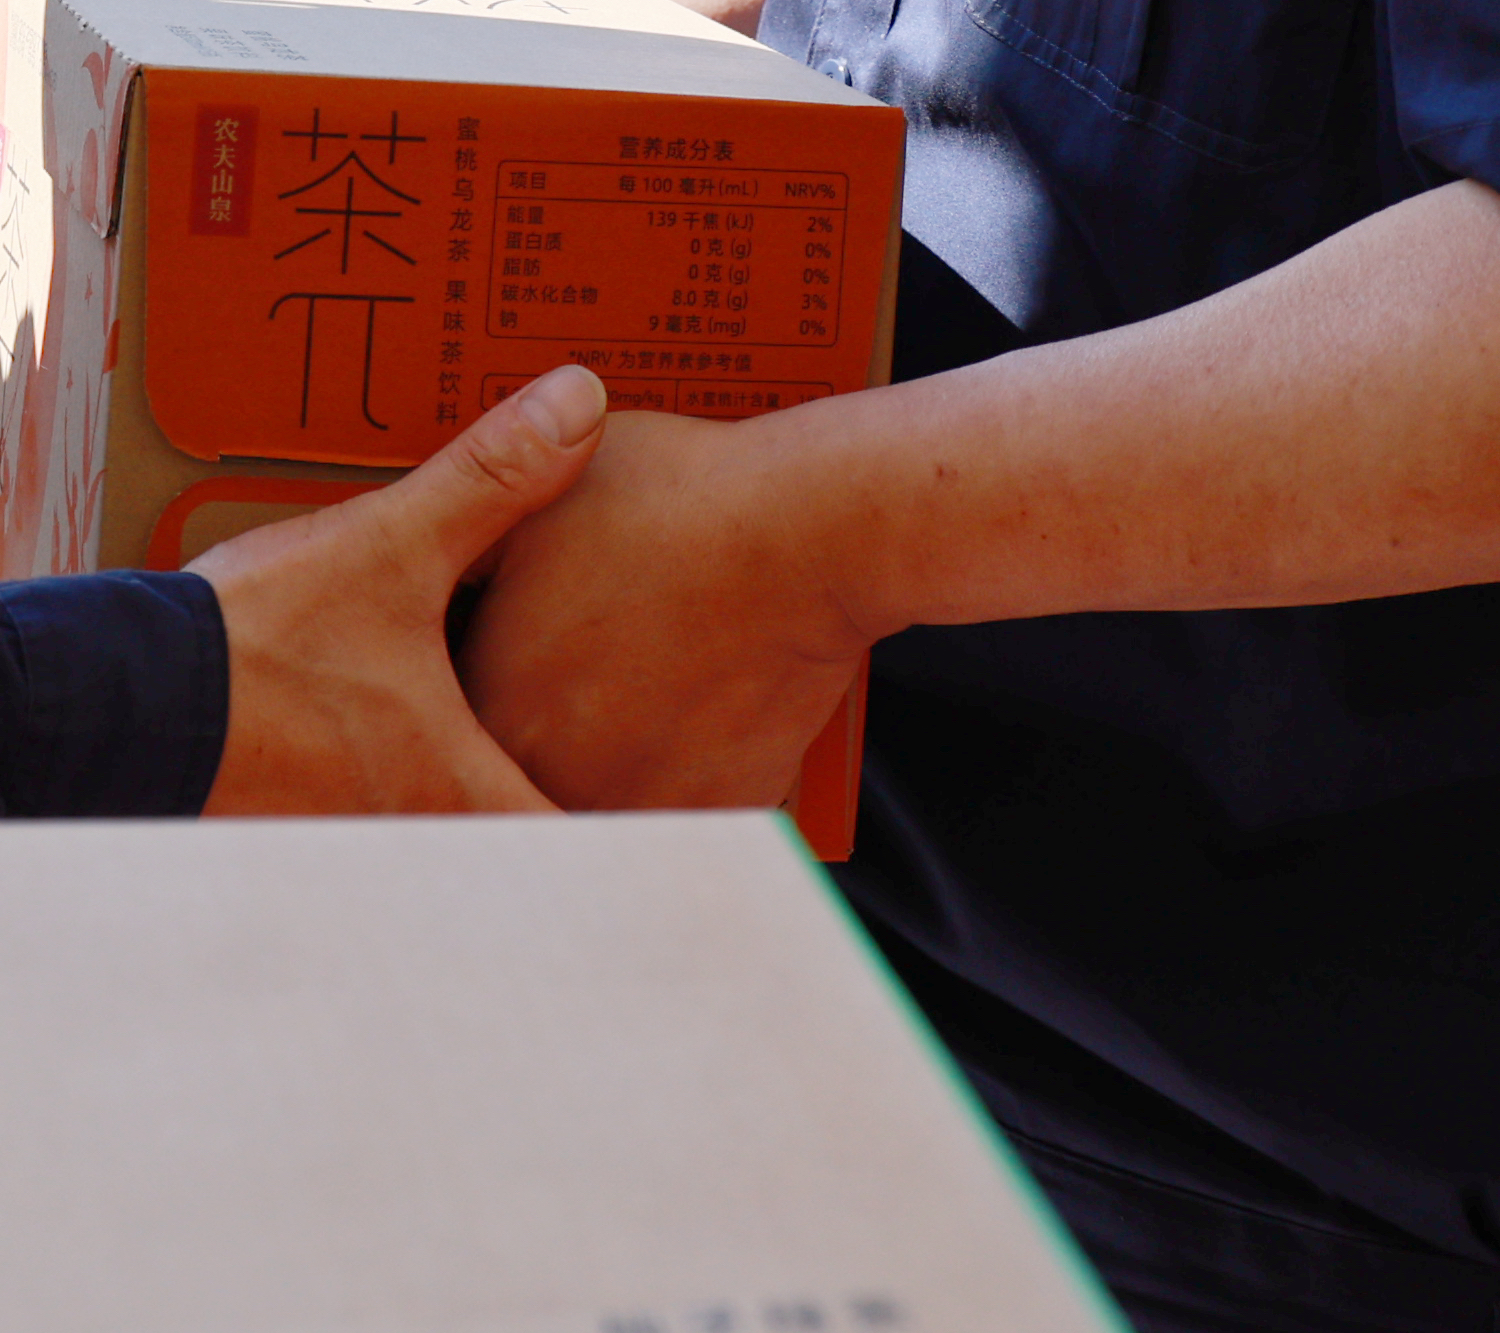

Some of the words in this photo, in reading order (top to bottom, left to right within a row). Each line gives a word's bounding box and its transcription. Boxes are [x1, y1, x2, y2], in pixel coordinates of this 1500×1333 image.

[618, 136, 736, 162] 营养成分表
[208, 116, 241, 223] 农夫山泉
[447, 115, 481, 264] 蜜桃乌龙茶
[509, 171, 548, 191] 项目
[784, 181, 837, 200] NRV%
[506, 205, 545, 226] 能量
[646, 210, 678, 228] 139
[806, 216, 834, 234] 2%
[504, 231, 564, 252] 蛋白质
[804, 242, 832, 260] 0%
[268, 107, 427, 432] 茶π
[502, 257, 542, 277] 脂肪
[802, 268, 830, 285] 0%
[500, 284, 599, 306] 碳水化合物
[671, 289, 698, 307] 8.0
[800, 293, 829, 312] 3%
[499, 310, 518, 330] 钠
[799, 319, 827, 337] 0%
[435, 280, 467, 427] 果味茶饮料
